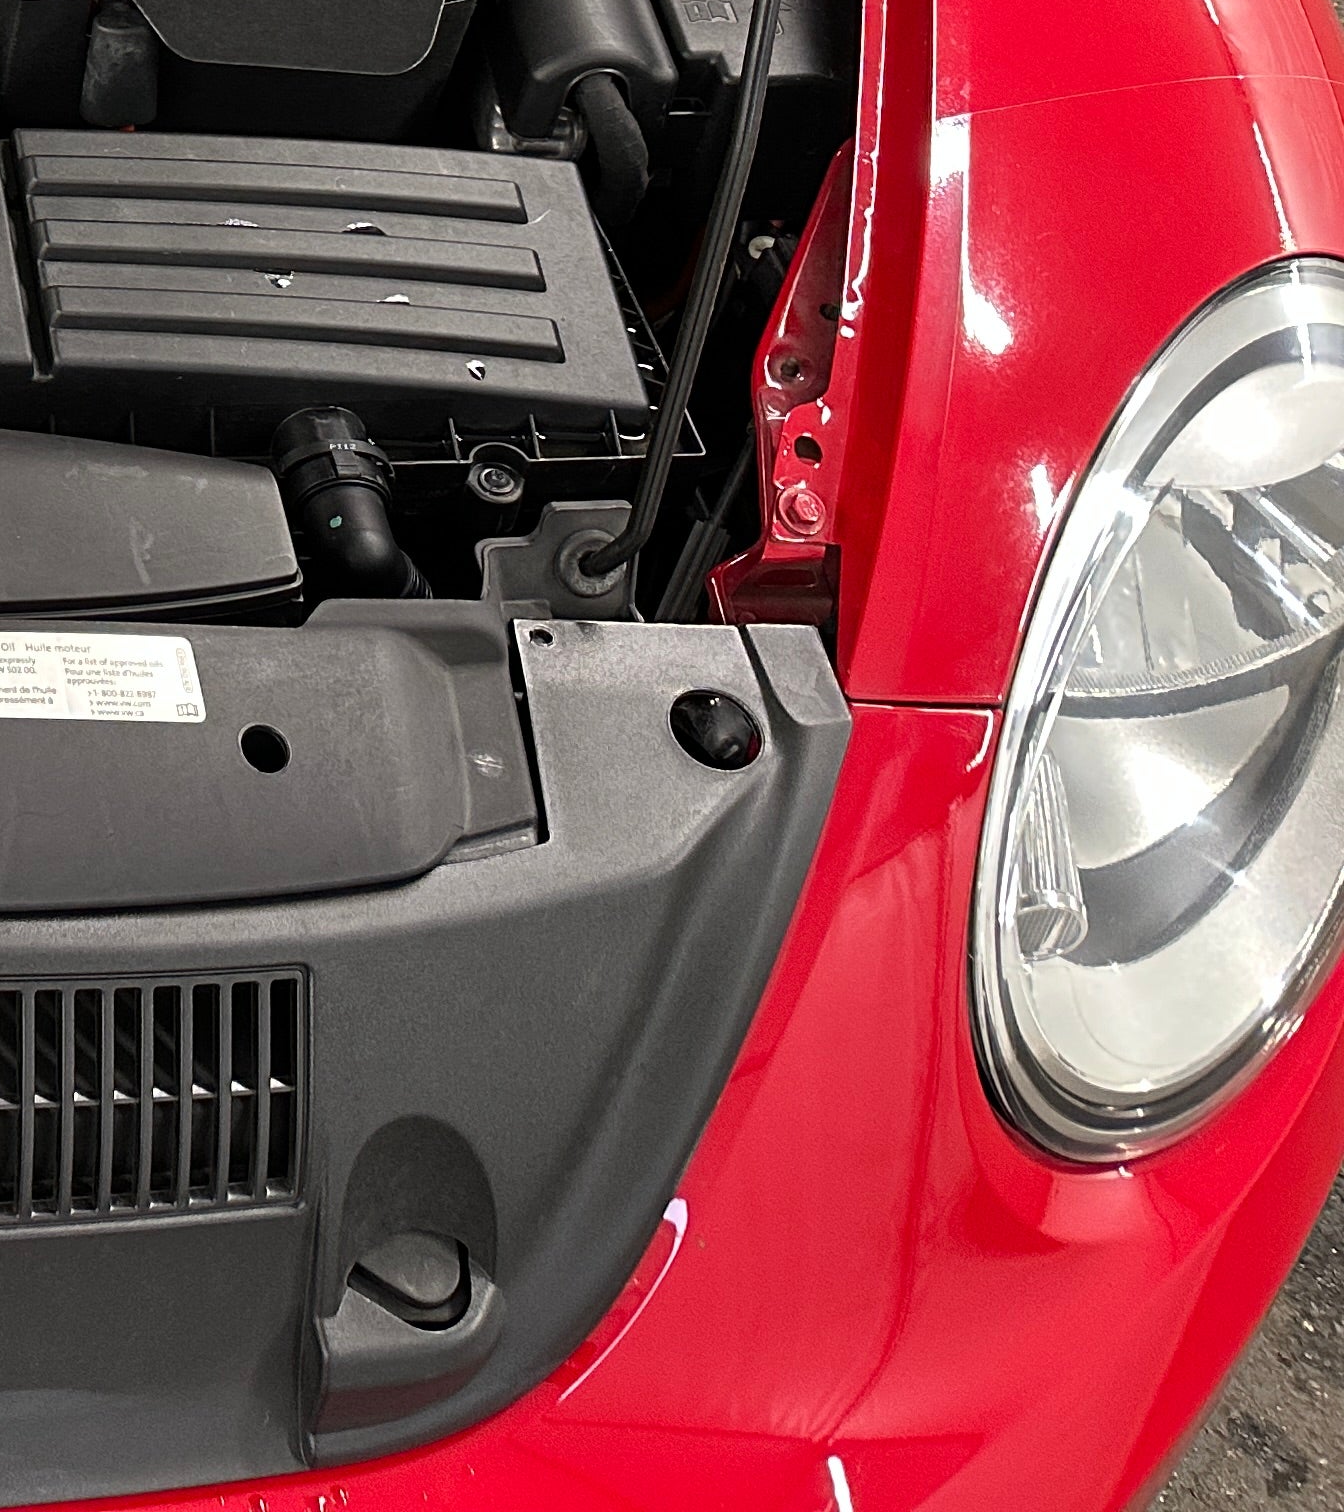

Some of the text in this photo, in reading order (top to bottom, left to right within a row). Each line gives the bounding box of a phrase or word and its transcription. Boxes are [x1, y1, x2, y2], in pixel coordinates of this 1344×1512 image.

[1, 642, 16, 651] Oil
[25, 643, 52, 652] Huile
[55, 644, 92, 653] moteur
